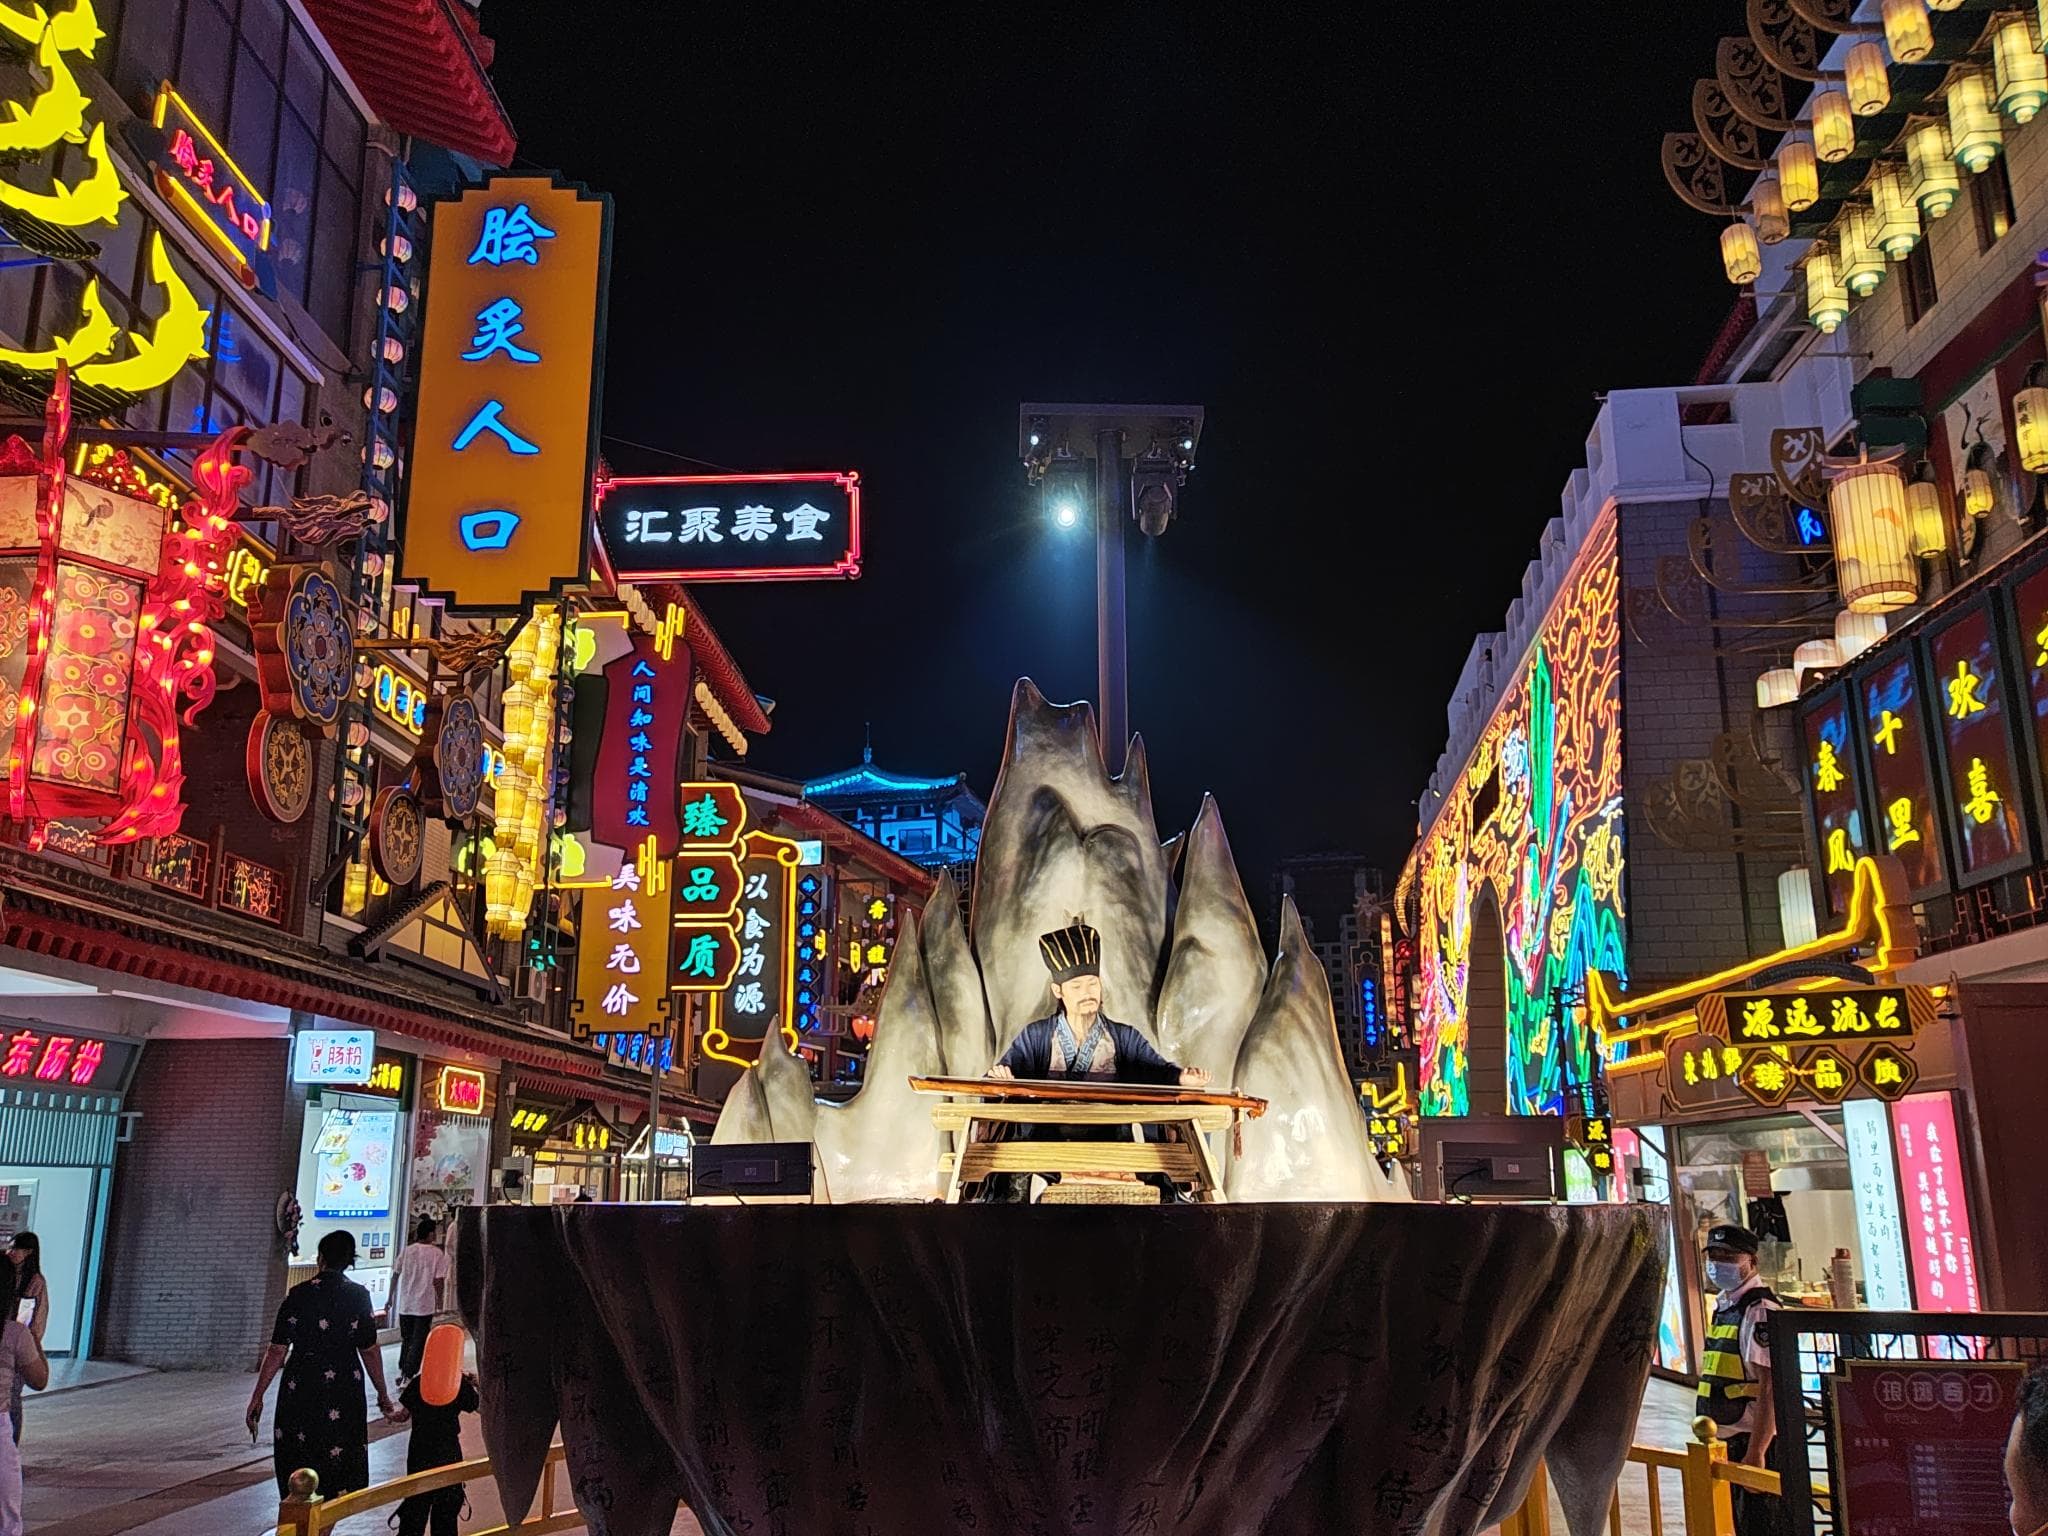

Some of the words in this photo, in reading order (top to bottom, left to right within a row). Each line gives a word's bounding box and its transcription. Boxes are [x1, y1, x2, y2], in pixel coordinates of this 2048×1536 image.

[453, 203, 557, 552] 脍炙人口
[624, 502, 831, 544] 汇聚美食
[626, 660, 656, 827] 人间知味是清欢
[1874, 710, 1920, 852] 十里
[601, 863, 643, 1017] 美味无价
[679, 793, 728, 978] 臻品质
[733, 873, 771, 1015] 以食为源
[0, 1030, 104, 1084] 东肠粉
[1742, 996, 1901, 1039] 源远流长
[1752, 1056, 1902, 1091] 臻品质
